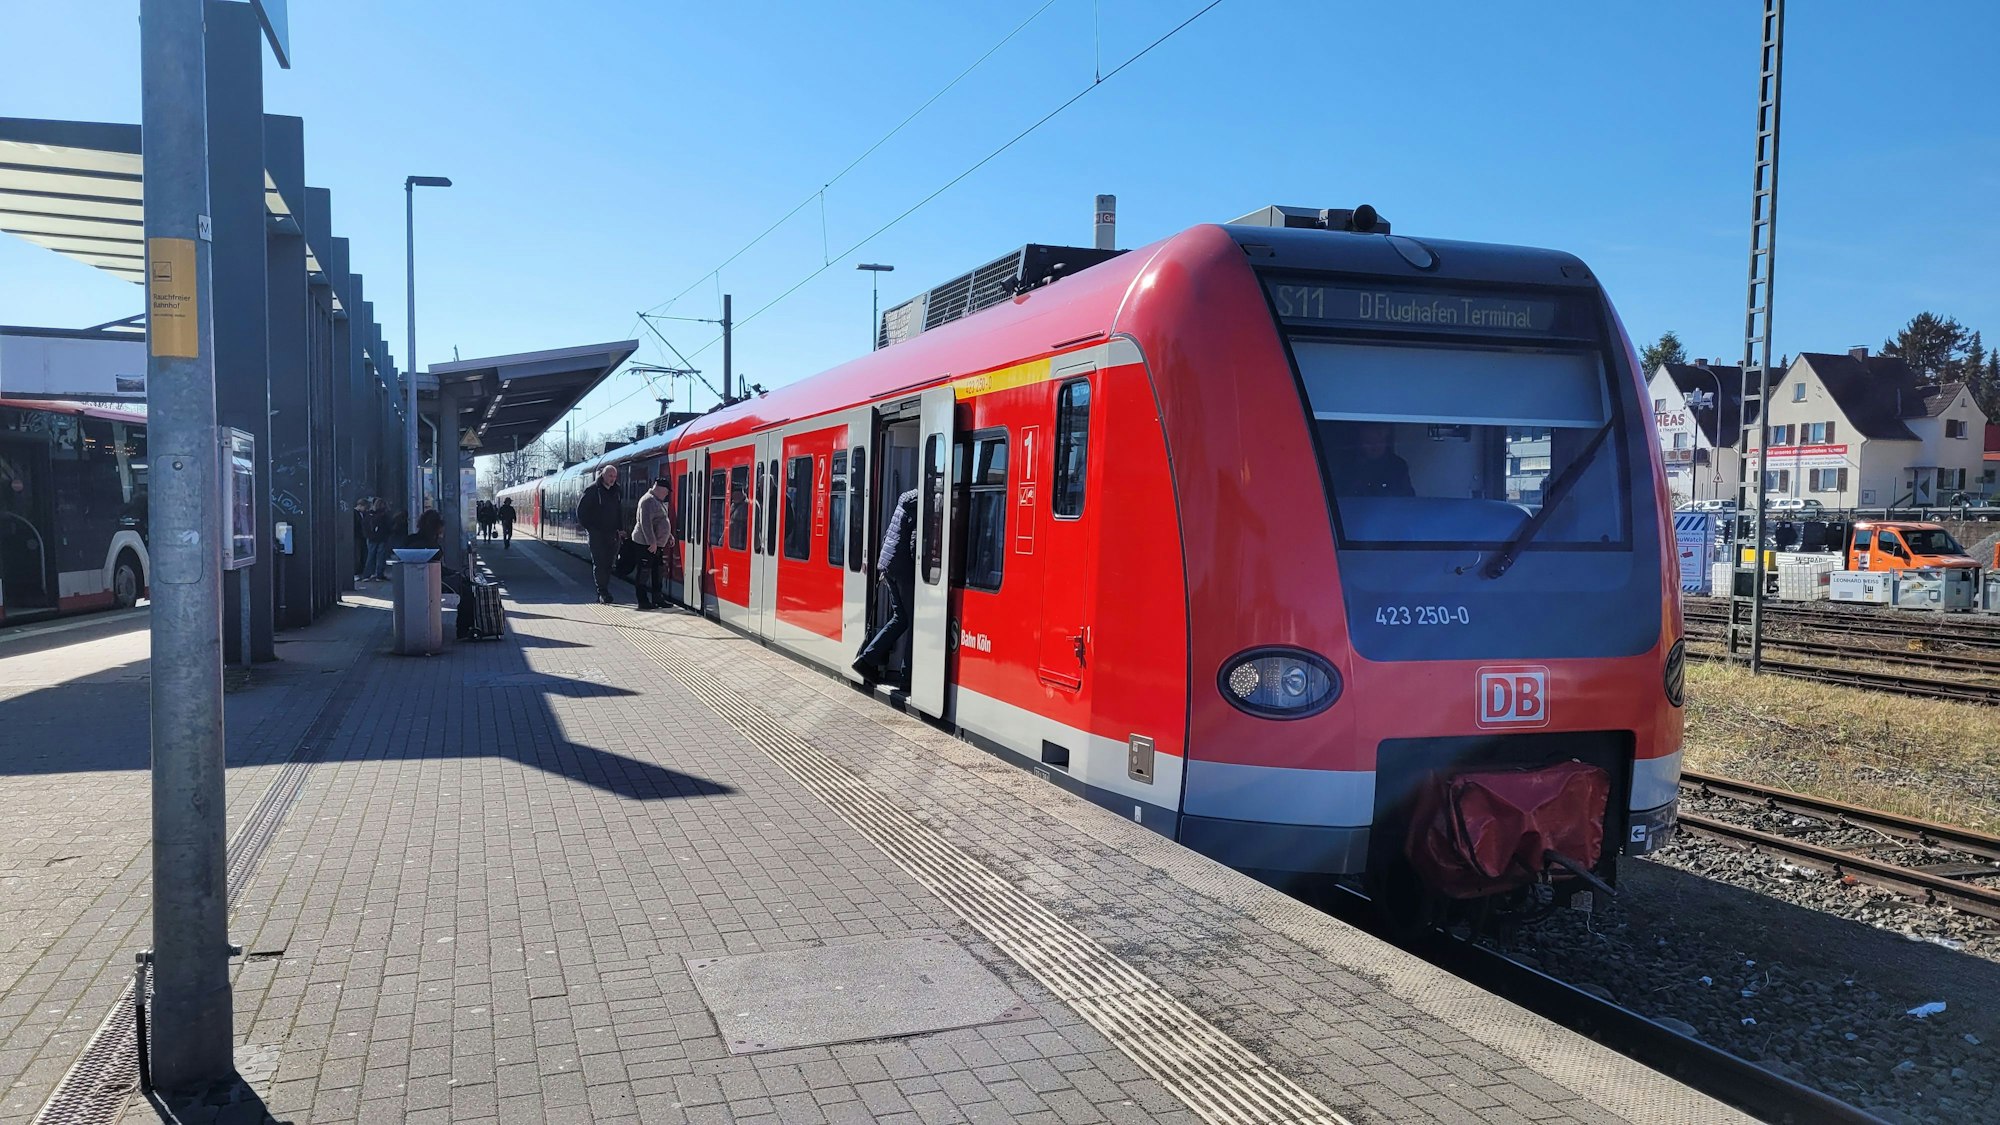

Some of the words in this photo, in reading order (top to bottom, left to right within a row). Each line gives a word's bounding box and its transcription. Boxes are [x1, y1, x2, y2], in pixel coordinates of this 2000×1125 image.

[153, 293, 191, 302] Rauchfreier
[153, 301, 180, 309] Bahnhof
[1277, 286, 1325, 319] S11
[1461, 299, 1532, 328] Terminal
[1024, 431, 1033, 479] 1
[818, 458, 825, 489] 2
[1375, 606, 1412, 625] 423
[1415, 606, 1470, 625] 250-0
[977, 633, 992, 653] Köln
[1485, 676, 1542, 719] DB
